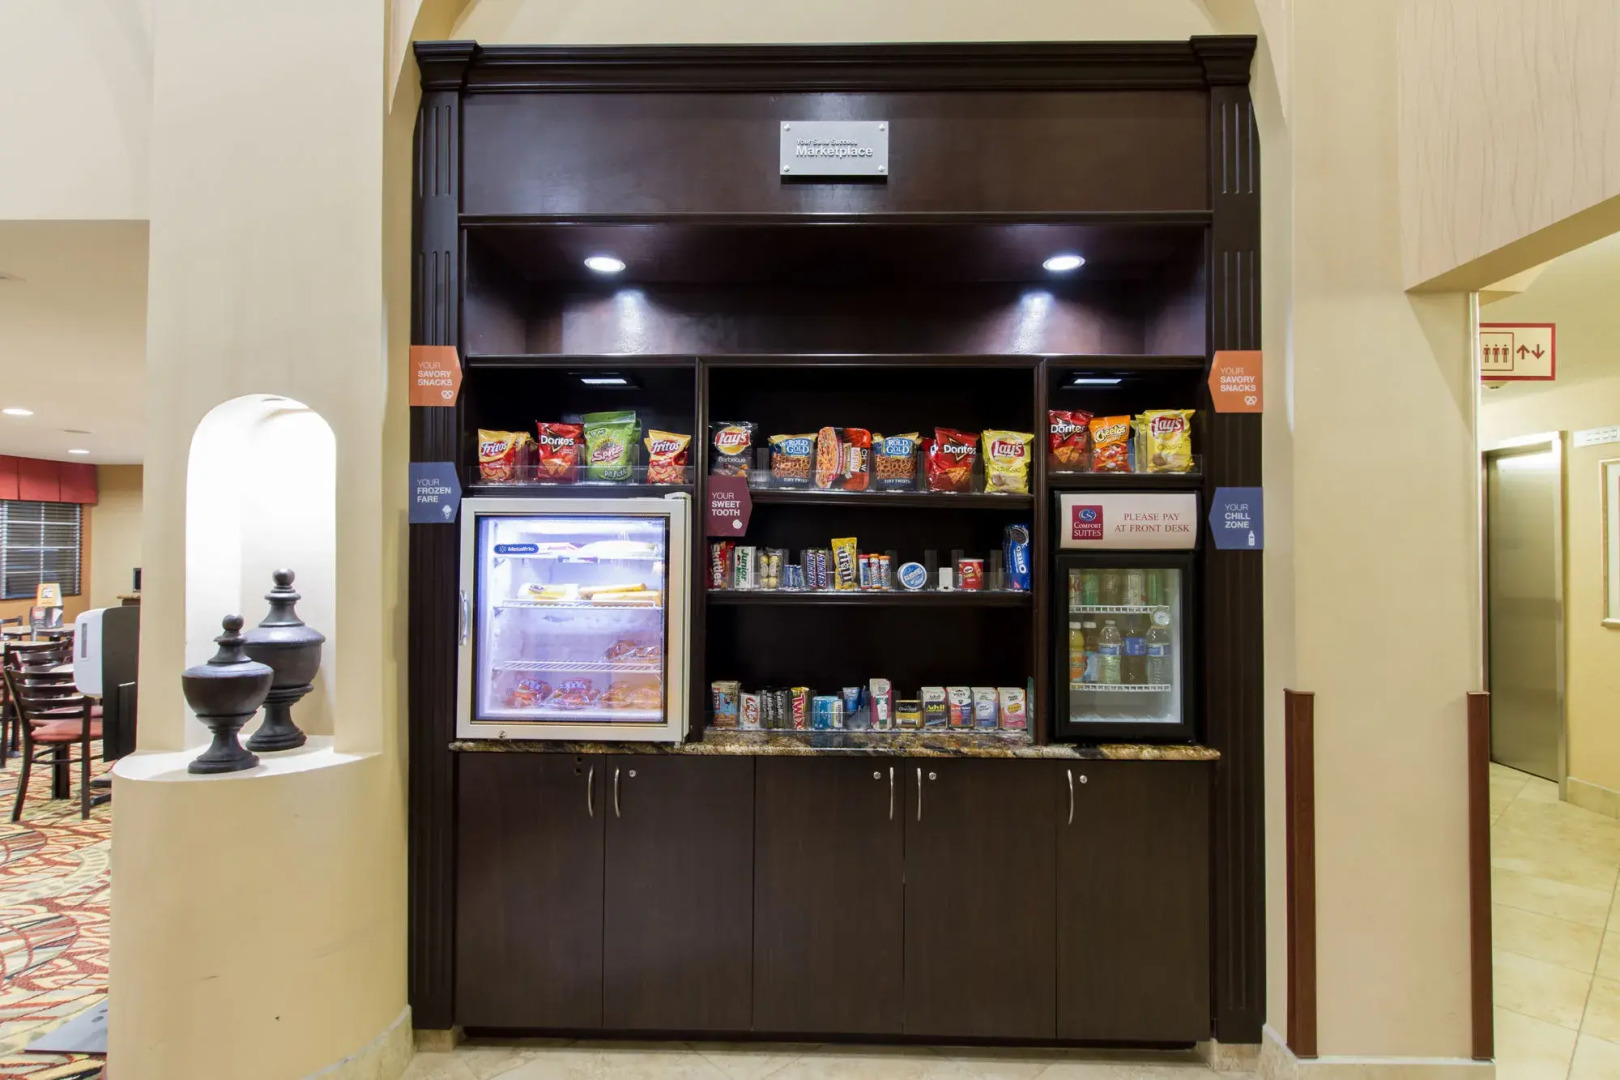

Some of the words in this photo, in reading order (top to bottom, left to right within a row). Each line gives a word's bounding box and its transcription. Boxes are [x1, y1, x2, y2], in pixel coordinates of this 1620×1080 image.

[796, 145, 873, 159] Marketplace
[418, 361, 441, 370] YOUR
[417, 370, 452, 378] SAVORY
[1220, 367, 1244, 375] YOUR
[417, 378, 453, 387] SNACKS
[1220, 375, 1256, 384] SAVORY
[1220, 384, 1257, 392] SNACKS
[1050, 424, 1085, 434] Doritos
[1153, 416, 1182, 436] Lay's
[1095, 425, 1127, 442] Cheetos
[540, 433, 575, 447] Doritos
[718, 430, 748, 447] Lay's
[480, 439, 508, 457] Fritos
[650, 438, 681, 456] Fritos
[786, 445, 810, 453] GOLD
[886, 445, 910, 454] GOLD
[943, 443, 977, 455] Doritos
[993, 440, 1022, 457] Lay's
[851, 448, 860, 472] MEIN
[417, 478, 440, 487] YOUR
[417, 487, 452, 495] FROZEN
[417, 495, 439, 503] FARE
[711, 492, 735, 500] YOUR
[711, 500, 741, 508] SWEET
[1224, 503, 1249, 512] YOUR
[711, 508, 741, 516] TOOTH
[1123, 512, 1160, 521] PLEASE
[1162, 512, 1180, 521] PAY
[1224, 512, 1251, 520] CHILL
[1114, 524, 1126, 532] AT
[1129, 524, 1162, 532] FRONT
[1164, 524, 1190, 533] DESK
[1224, 520, 1250, 529] ZONE
[1074, 529, 1102, 537] SUITES
[1015, 545, 1028, 575] OREO
[740, 548, 749, 582] Junior
[807, 553, 816, 588] SNICKERS
[817, 553, 826, 588] SNICKERS
